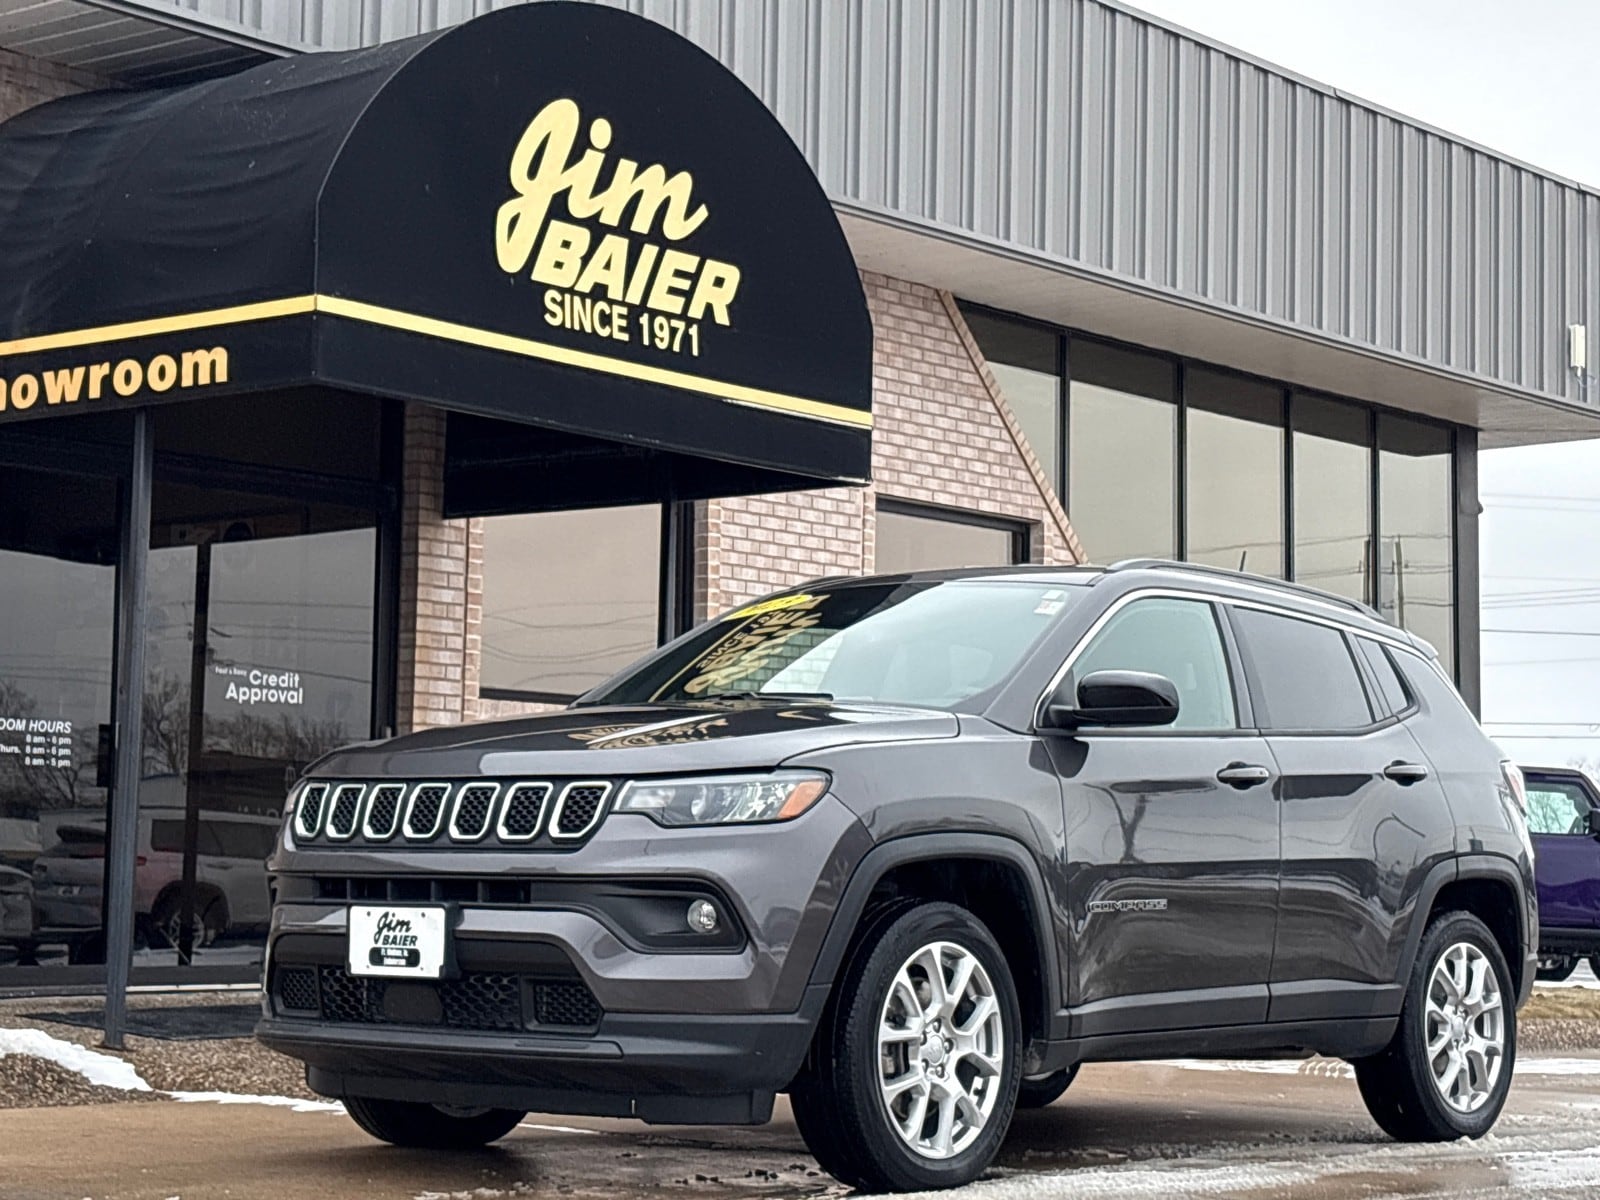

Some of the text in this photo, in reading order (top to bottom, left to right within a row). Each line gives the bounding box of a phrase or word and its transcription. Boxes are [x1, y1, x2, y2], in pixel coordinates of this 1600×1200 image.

[496, 98, 709, 273] Jim
[530, 219, 741, 326] BAIER
[543, 289, 699, 357] SINCE 1971
[0, 346, 228, 412] owroom
[249, 669, 300, 688] Credit
[225, 681, 303, 705] Approval
[29, 719, 72, 734] HOURS
[58, 737, 71, 746] pm
[58, 748, 71, 757] pm
[58, 759, 71, 768] pm
[1089, 899, 1168, 912] COMPASS
[374, 911, 412, 945] Jim
[382, 934, 418, 947] BAIER
